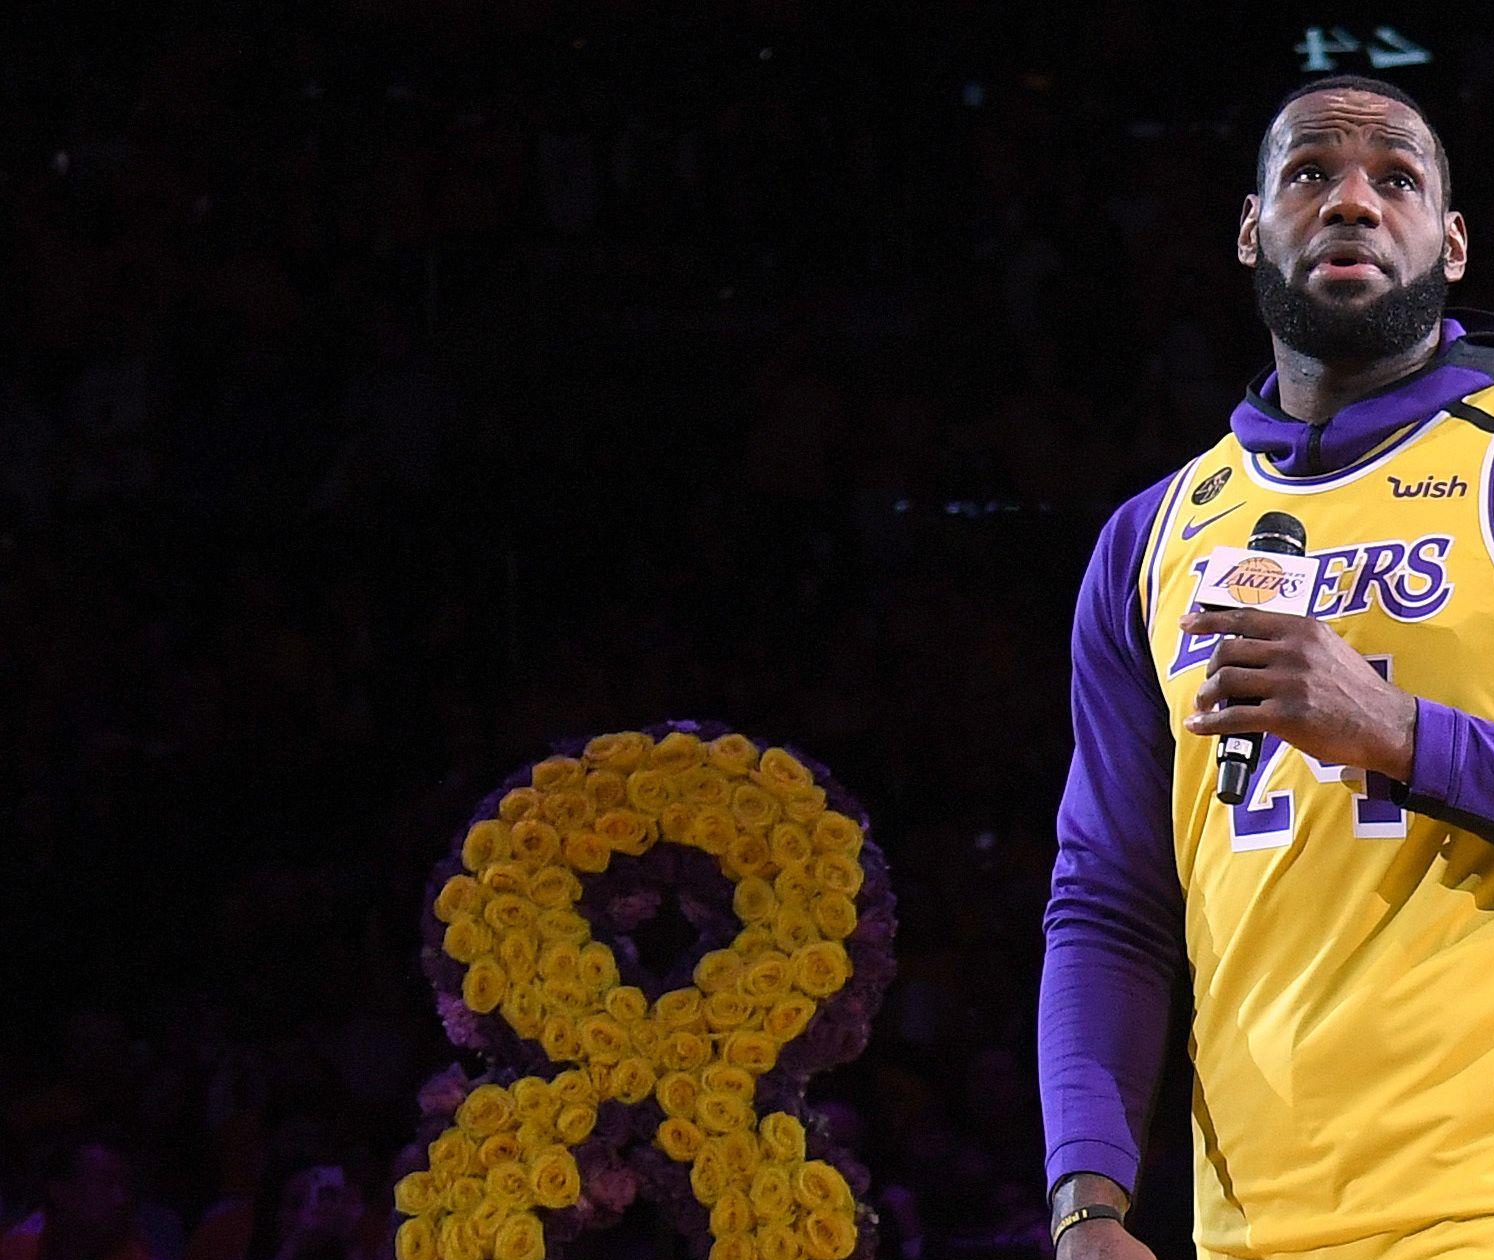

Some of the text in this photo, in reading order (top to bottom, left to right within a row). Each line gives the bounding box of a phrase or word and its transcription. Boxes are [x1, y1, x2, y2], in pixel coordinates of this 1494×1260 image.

[1388, 475, 1467, 498] wish
[1210, 565, 1306, 599] LAKERS
[1167, 533, 1456, 681] LERS
